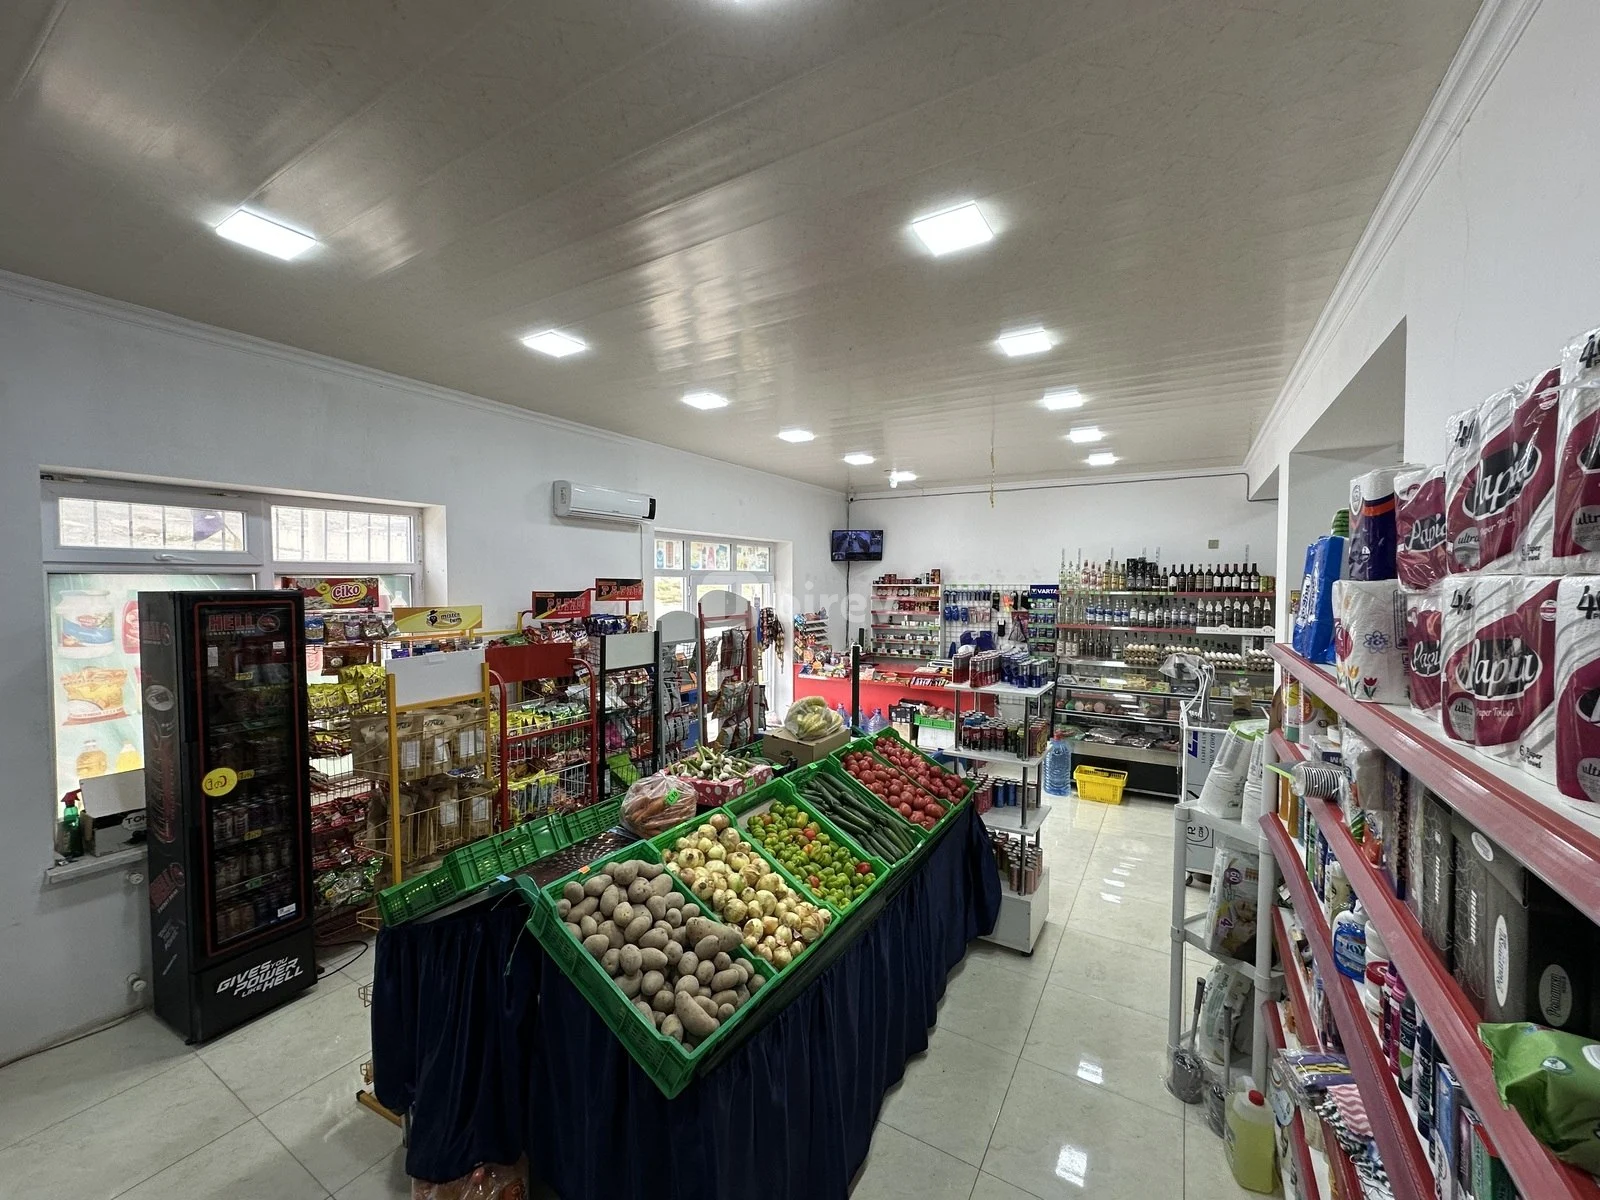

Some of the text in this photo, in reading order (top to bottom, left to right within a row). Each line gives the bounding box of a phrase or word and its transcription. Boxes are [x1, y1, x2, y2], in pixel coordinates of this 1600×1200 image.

[1576, 512, 1600, 526] ultr
[208, 614, 256, 632] HELL
[216, 957, 288, 993] GIVES YOU
[233, 958, 299, 996] POWER
[241, 966, 304, 998] LIKE HELL
